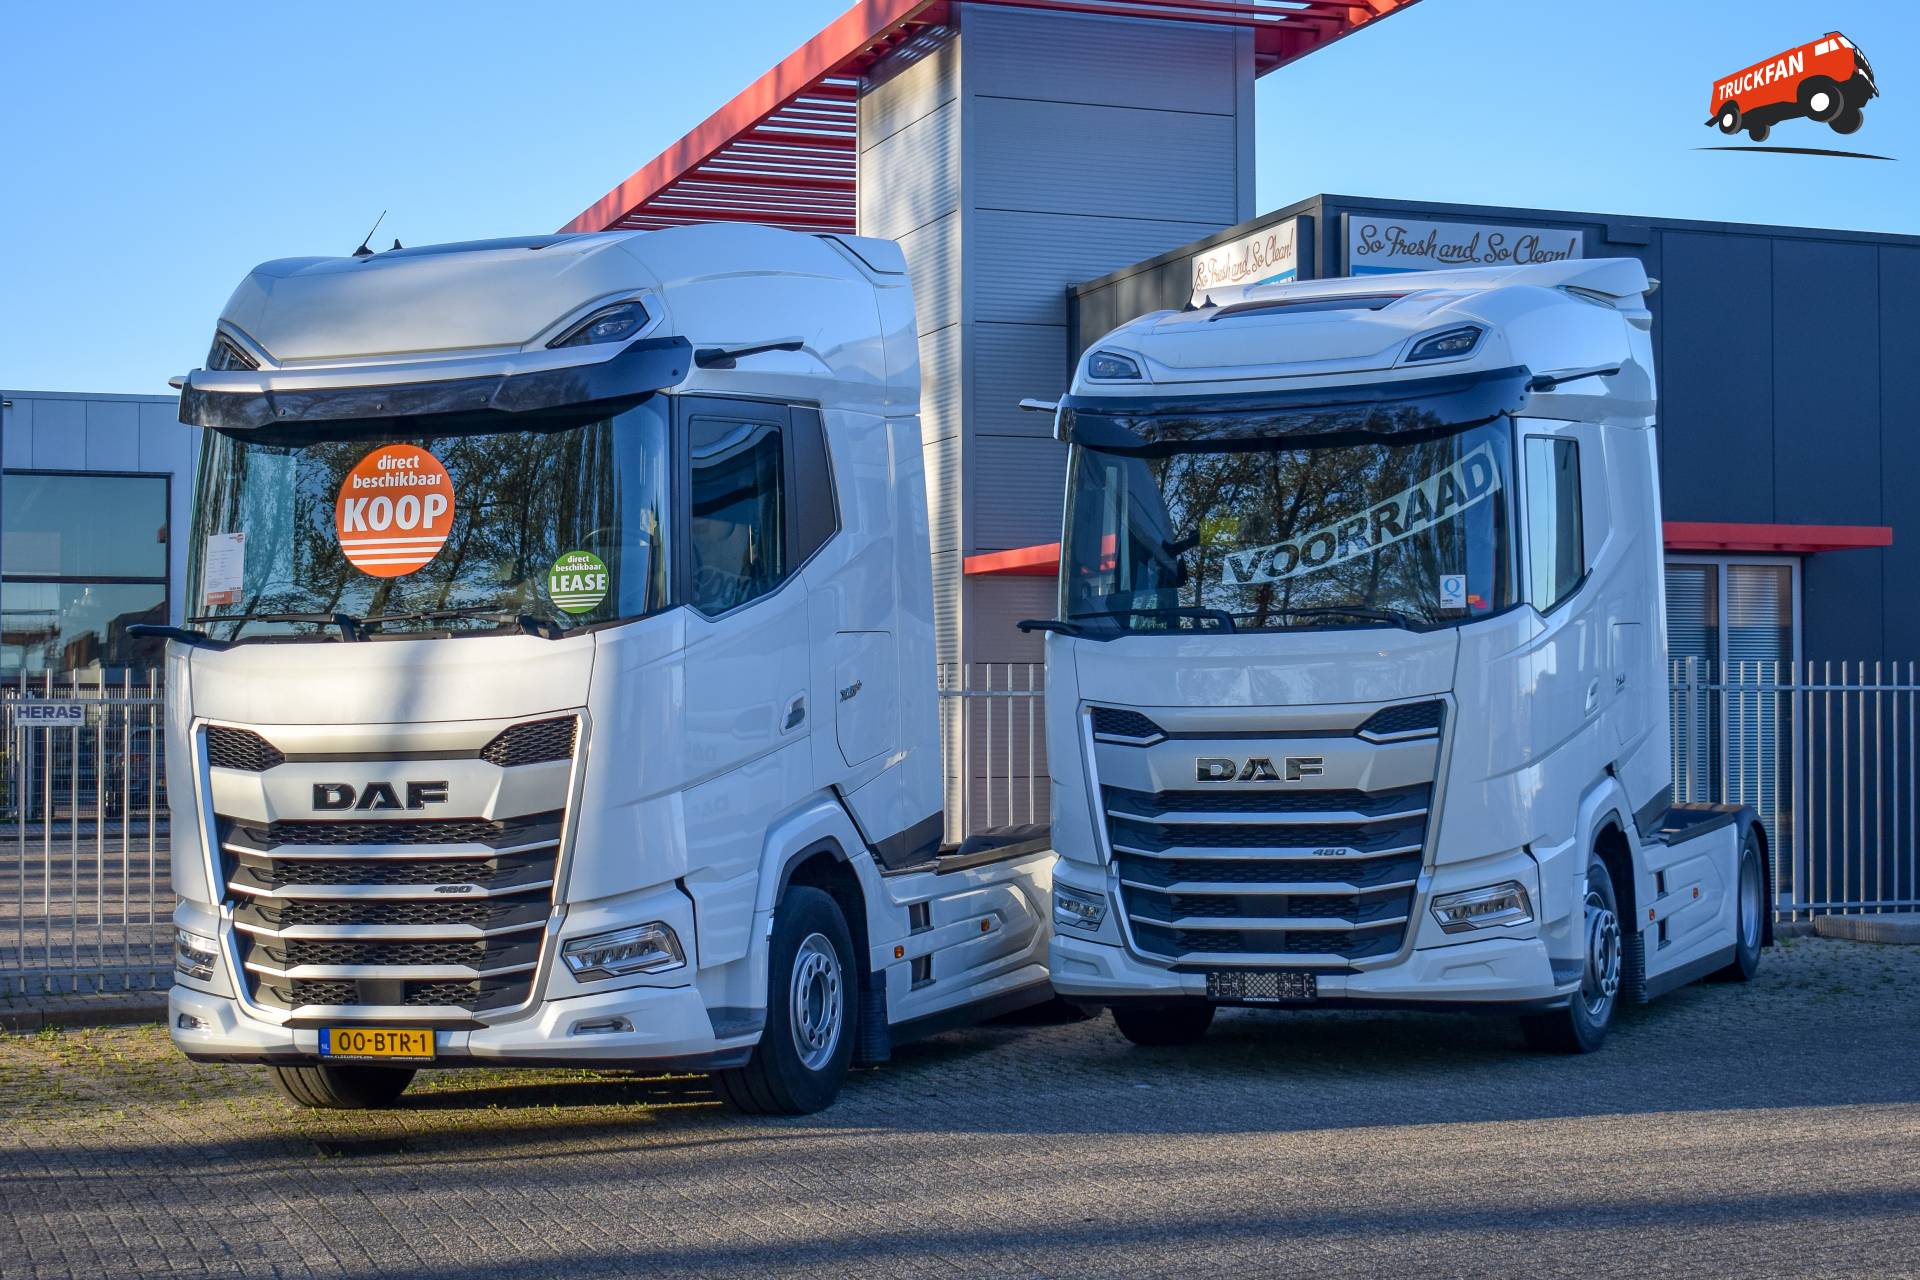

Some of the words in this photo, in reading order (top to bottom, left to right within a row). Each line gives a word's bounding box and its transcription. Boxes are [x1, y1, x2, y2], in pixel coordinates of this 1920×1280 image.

[1357, 224, 1385, 255] So
[1385, 225, 1437, 259] Fresh
[1436, 229, 1481, 264] and
[1484, 232, 1513, 264] So
[1196, 262, 1209, 291] So
[1208, 252, 1231, 287] Fresh
[1231, 243, 1251, 282] and
[1252, 241, 1265, 272] So
[1265, 227, 1294, 267] Clean!
[377, 455, 420, 470] direct
[352, 470, 442, 489] beschikbaar
[343, 493, 448, 533] KOOP
[1227, 452, 1493, 583] VOORRAAD
[555, 563, 602, 572] beschikbaar
[567, 555, 590, 563] direct
[551, 573, 606, 593] LEASE
[1444, 578, 1462, 598] Q
[17, 706, 82, 719] HERAS
[1195, 756, 1325, 783] DAF
[312, 780, 449, 811] DAF
[1312, 848, 1347, 857] 480
[339, 1031, 426, 1052] 00-BTR-1
